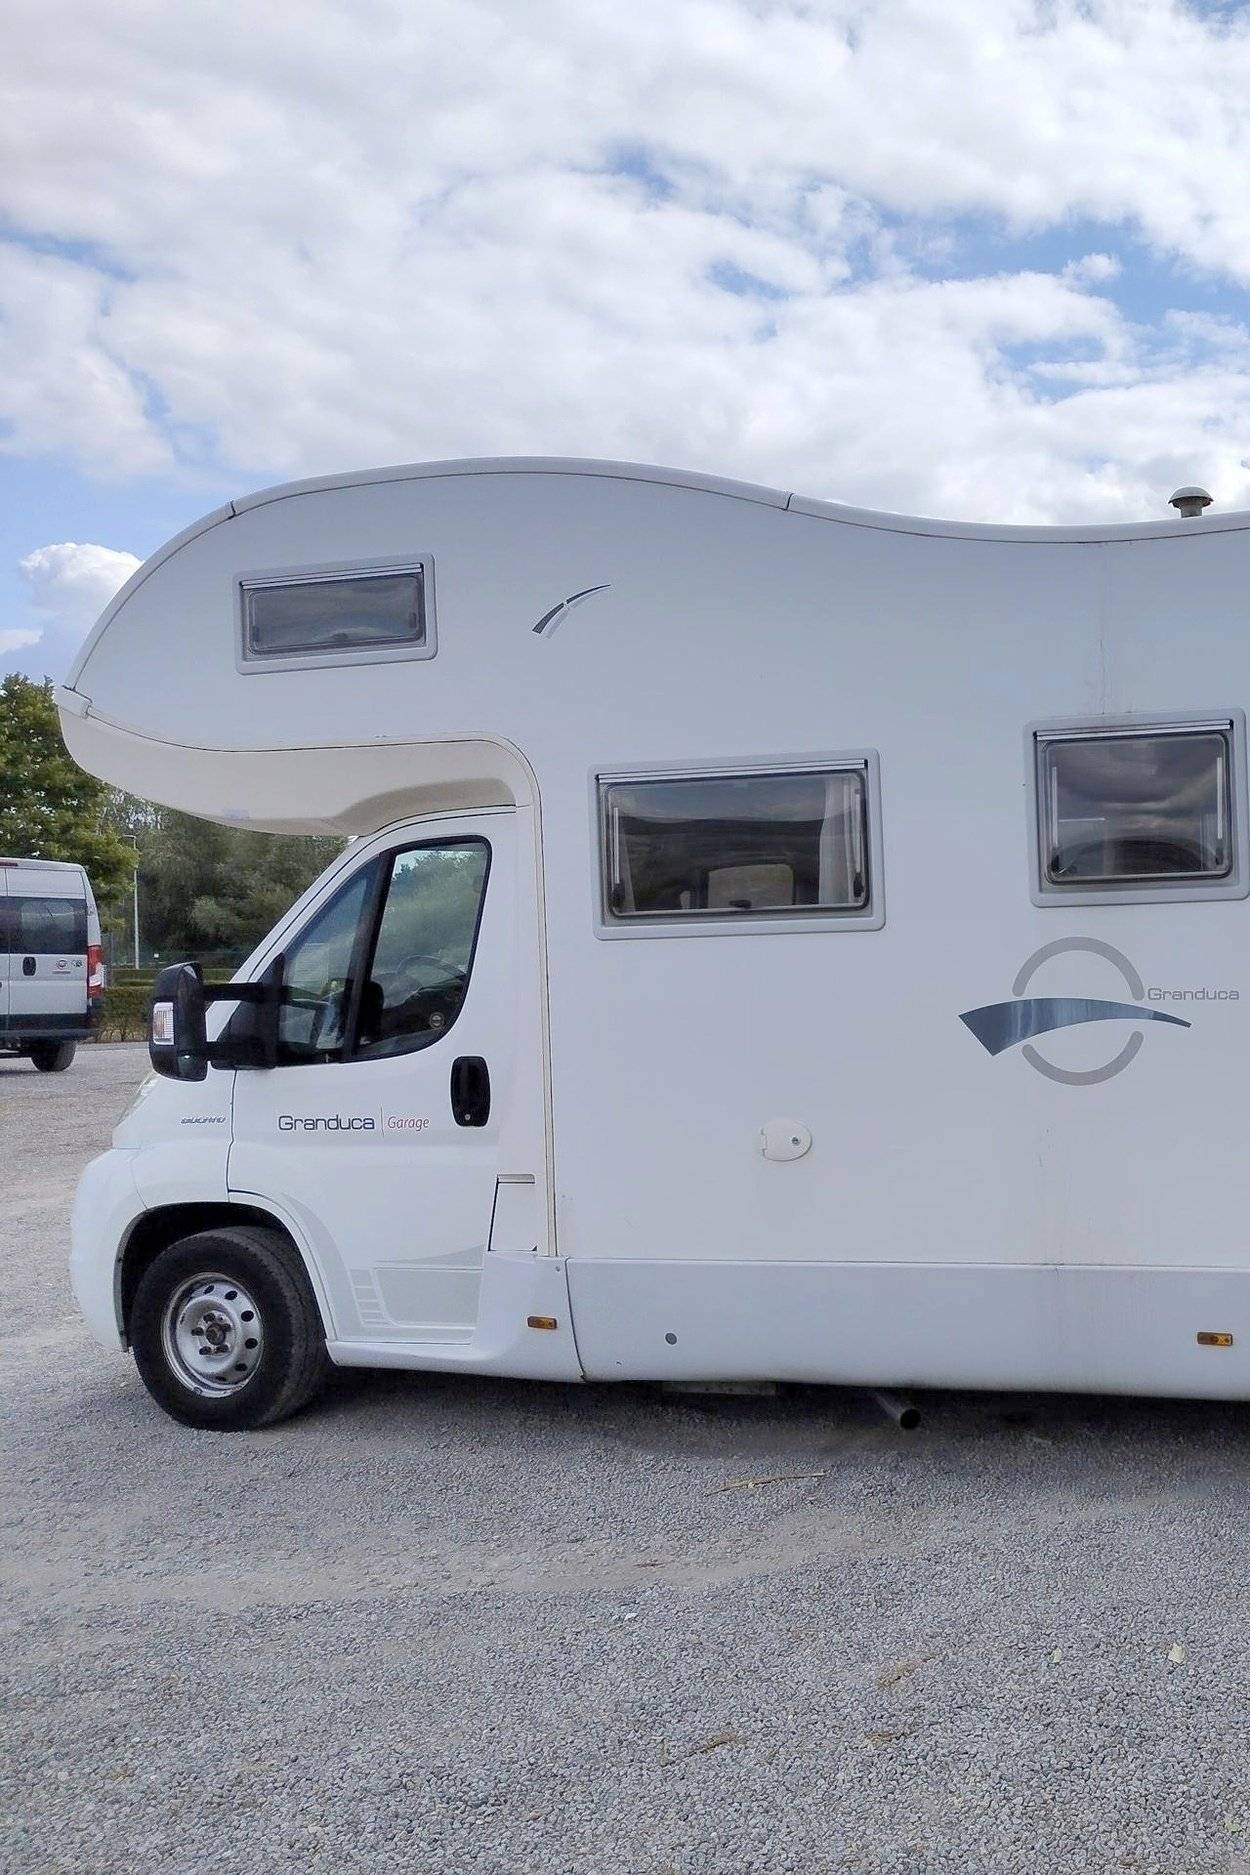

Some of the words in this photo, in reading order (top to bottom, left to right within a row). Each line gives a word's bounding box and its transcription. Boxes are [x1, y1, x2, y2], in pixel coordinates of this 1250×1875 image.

[1147, 987, 1240, 1001] Granduca
[278, 1114, 375, 1131] Granduca
[387, 1116, 430, 1132] Garage
